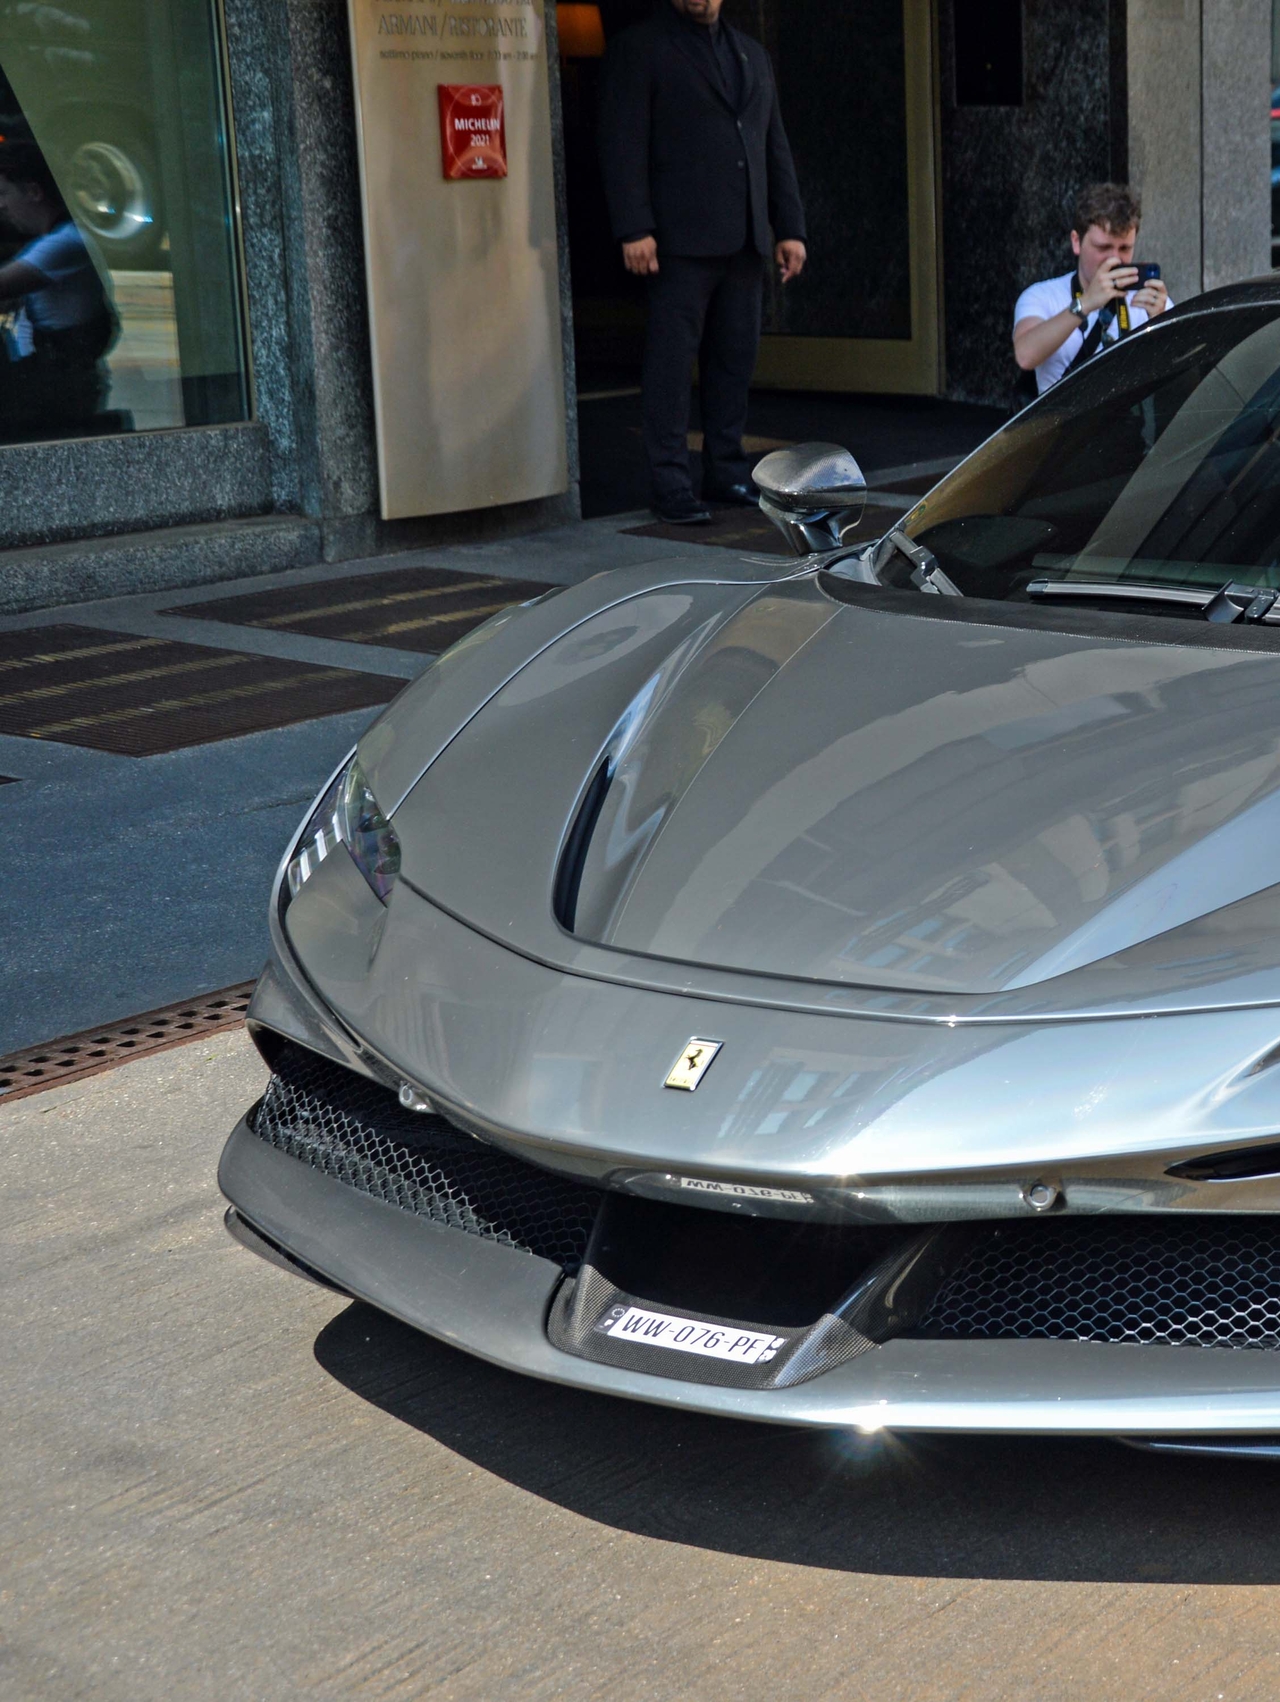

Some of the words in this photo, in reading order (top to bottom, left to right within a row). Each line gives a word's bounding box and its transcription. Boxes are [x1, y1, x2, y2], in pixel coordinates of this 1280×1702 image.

[454, 117, 501, 131] MICHELIN
[470, 133, 490, 147] 2021
[621, 1314, 766, 1356] WW-076-PF
